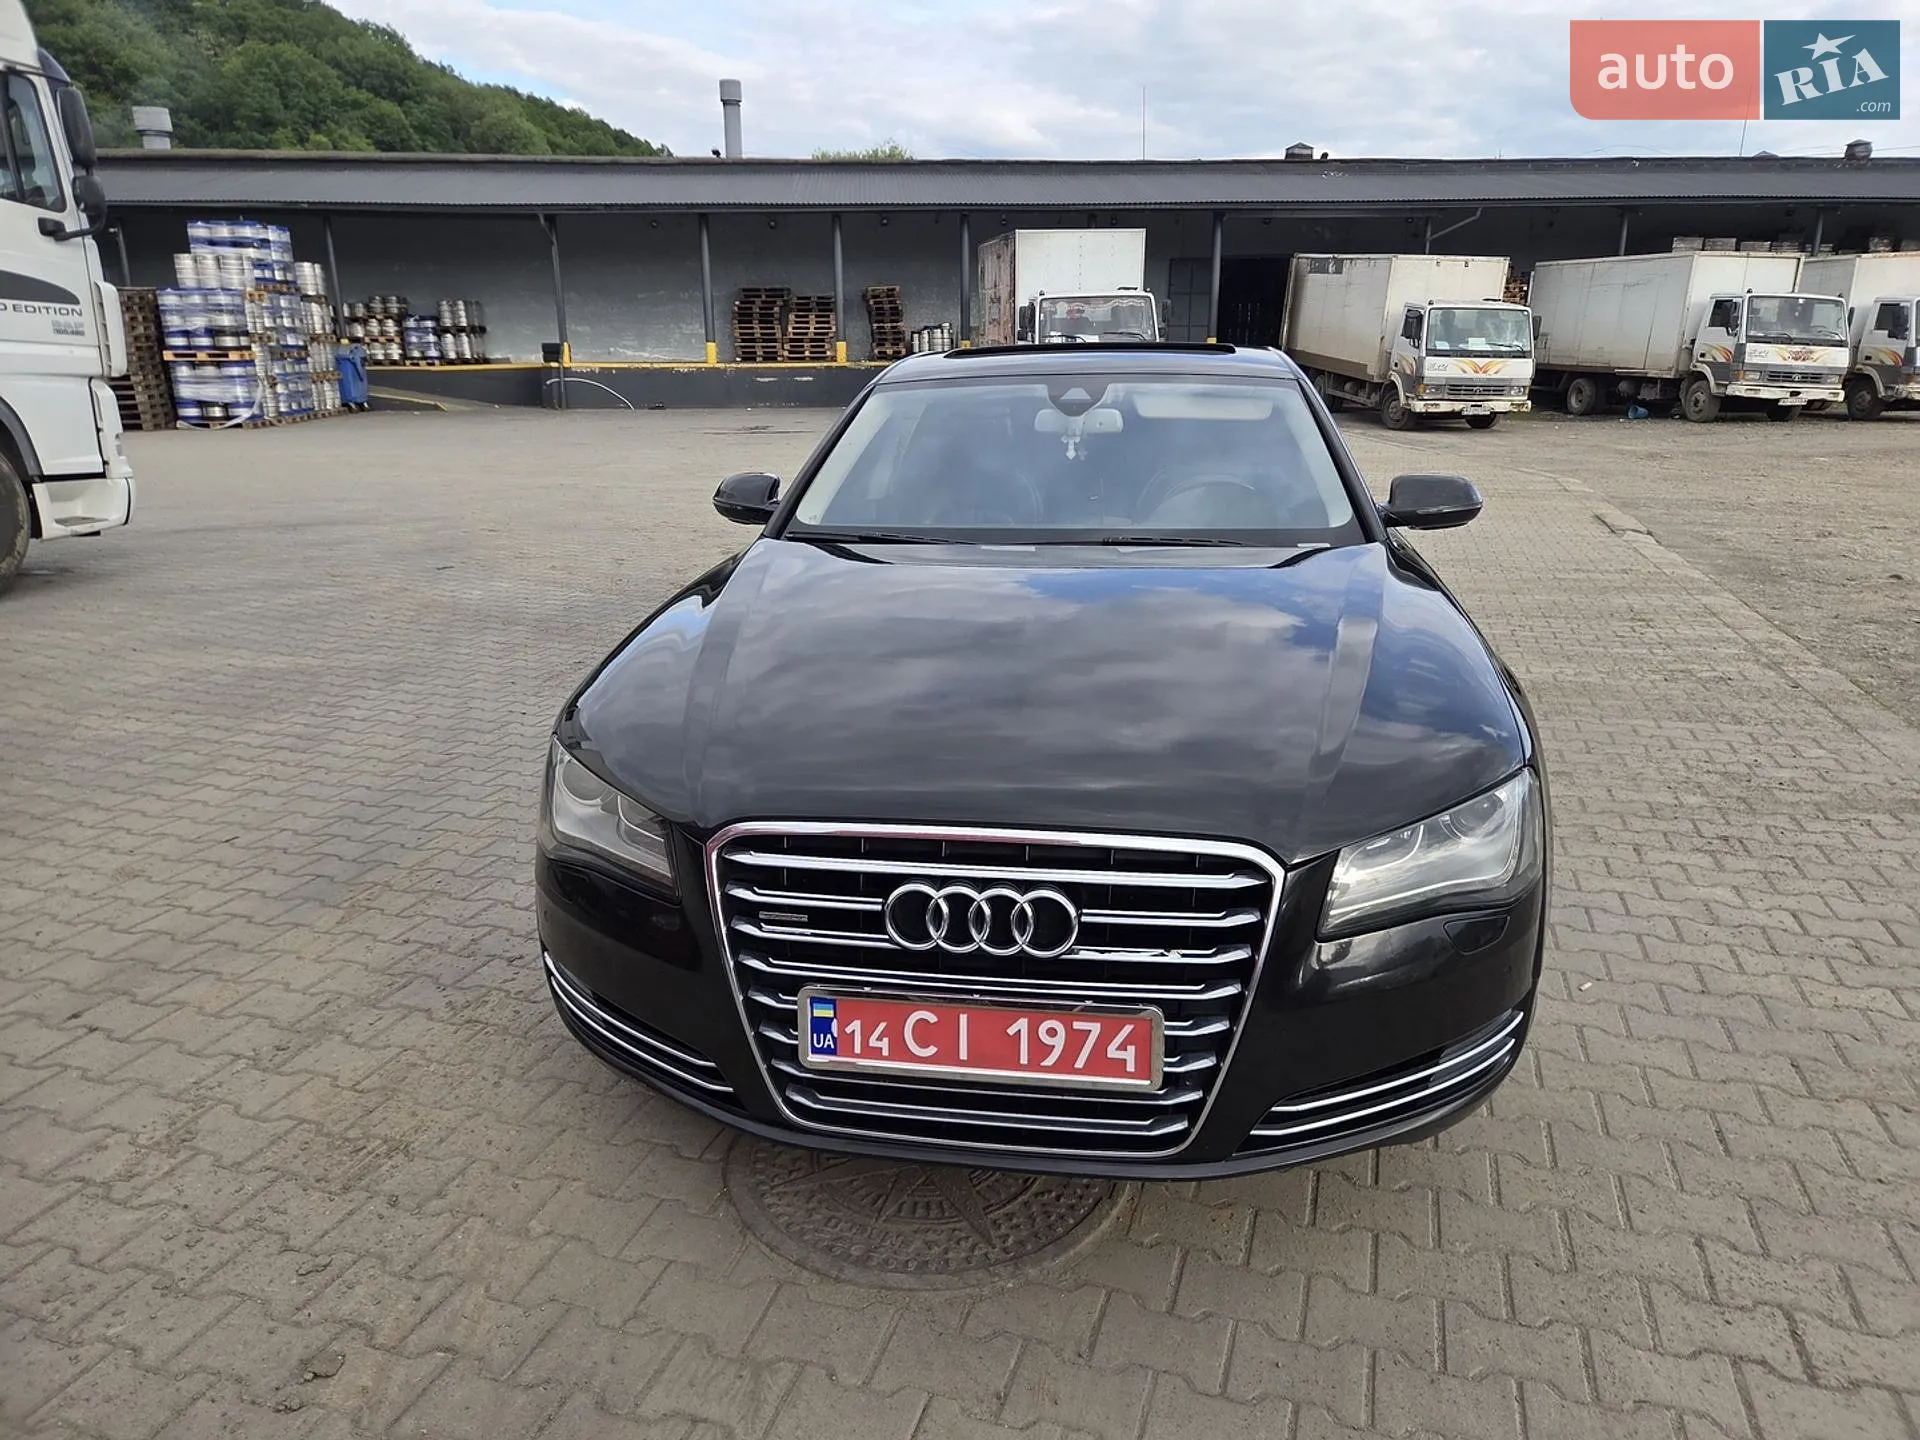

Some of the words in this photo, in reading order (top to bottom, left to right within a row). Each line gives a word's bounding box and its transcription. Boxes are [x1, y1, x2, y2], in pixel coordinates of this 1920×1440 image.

[12, 303, 83, 317] EDITION
[813, 1033, 834, 1049] UA
[1006, 1017, 1136, 1073] 1974
